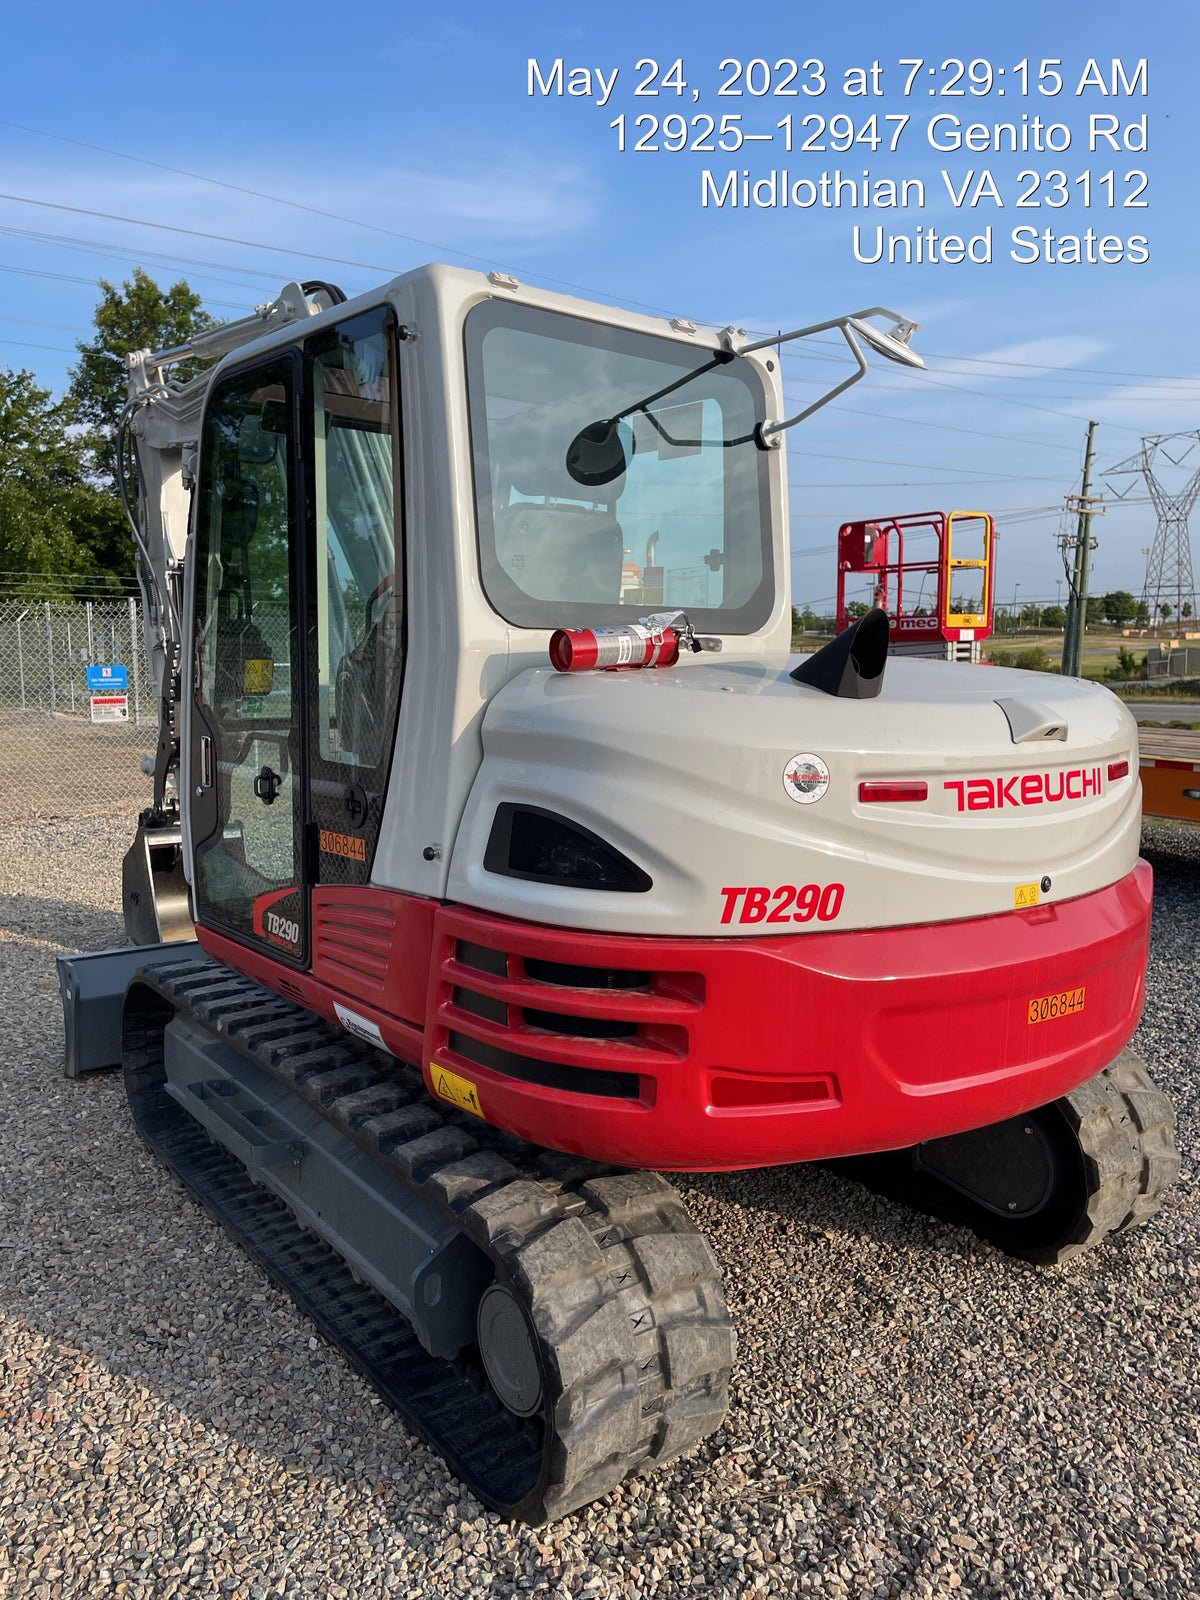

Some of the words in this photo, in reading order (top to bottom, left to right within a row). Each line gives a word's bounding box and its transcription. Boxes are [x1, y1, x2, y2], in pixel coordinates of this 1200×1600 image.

[901, 619, 938, 628] mec
[943, 767, 1101, 812] TAKEUCHI
[320, 831, 366, 859] 306844
[720, 883, 845, 924] TB290
[267, 912, 299, 943] TB290
[1029, 988, 1085, 1023] 306844
